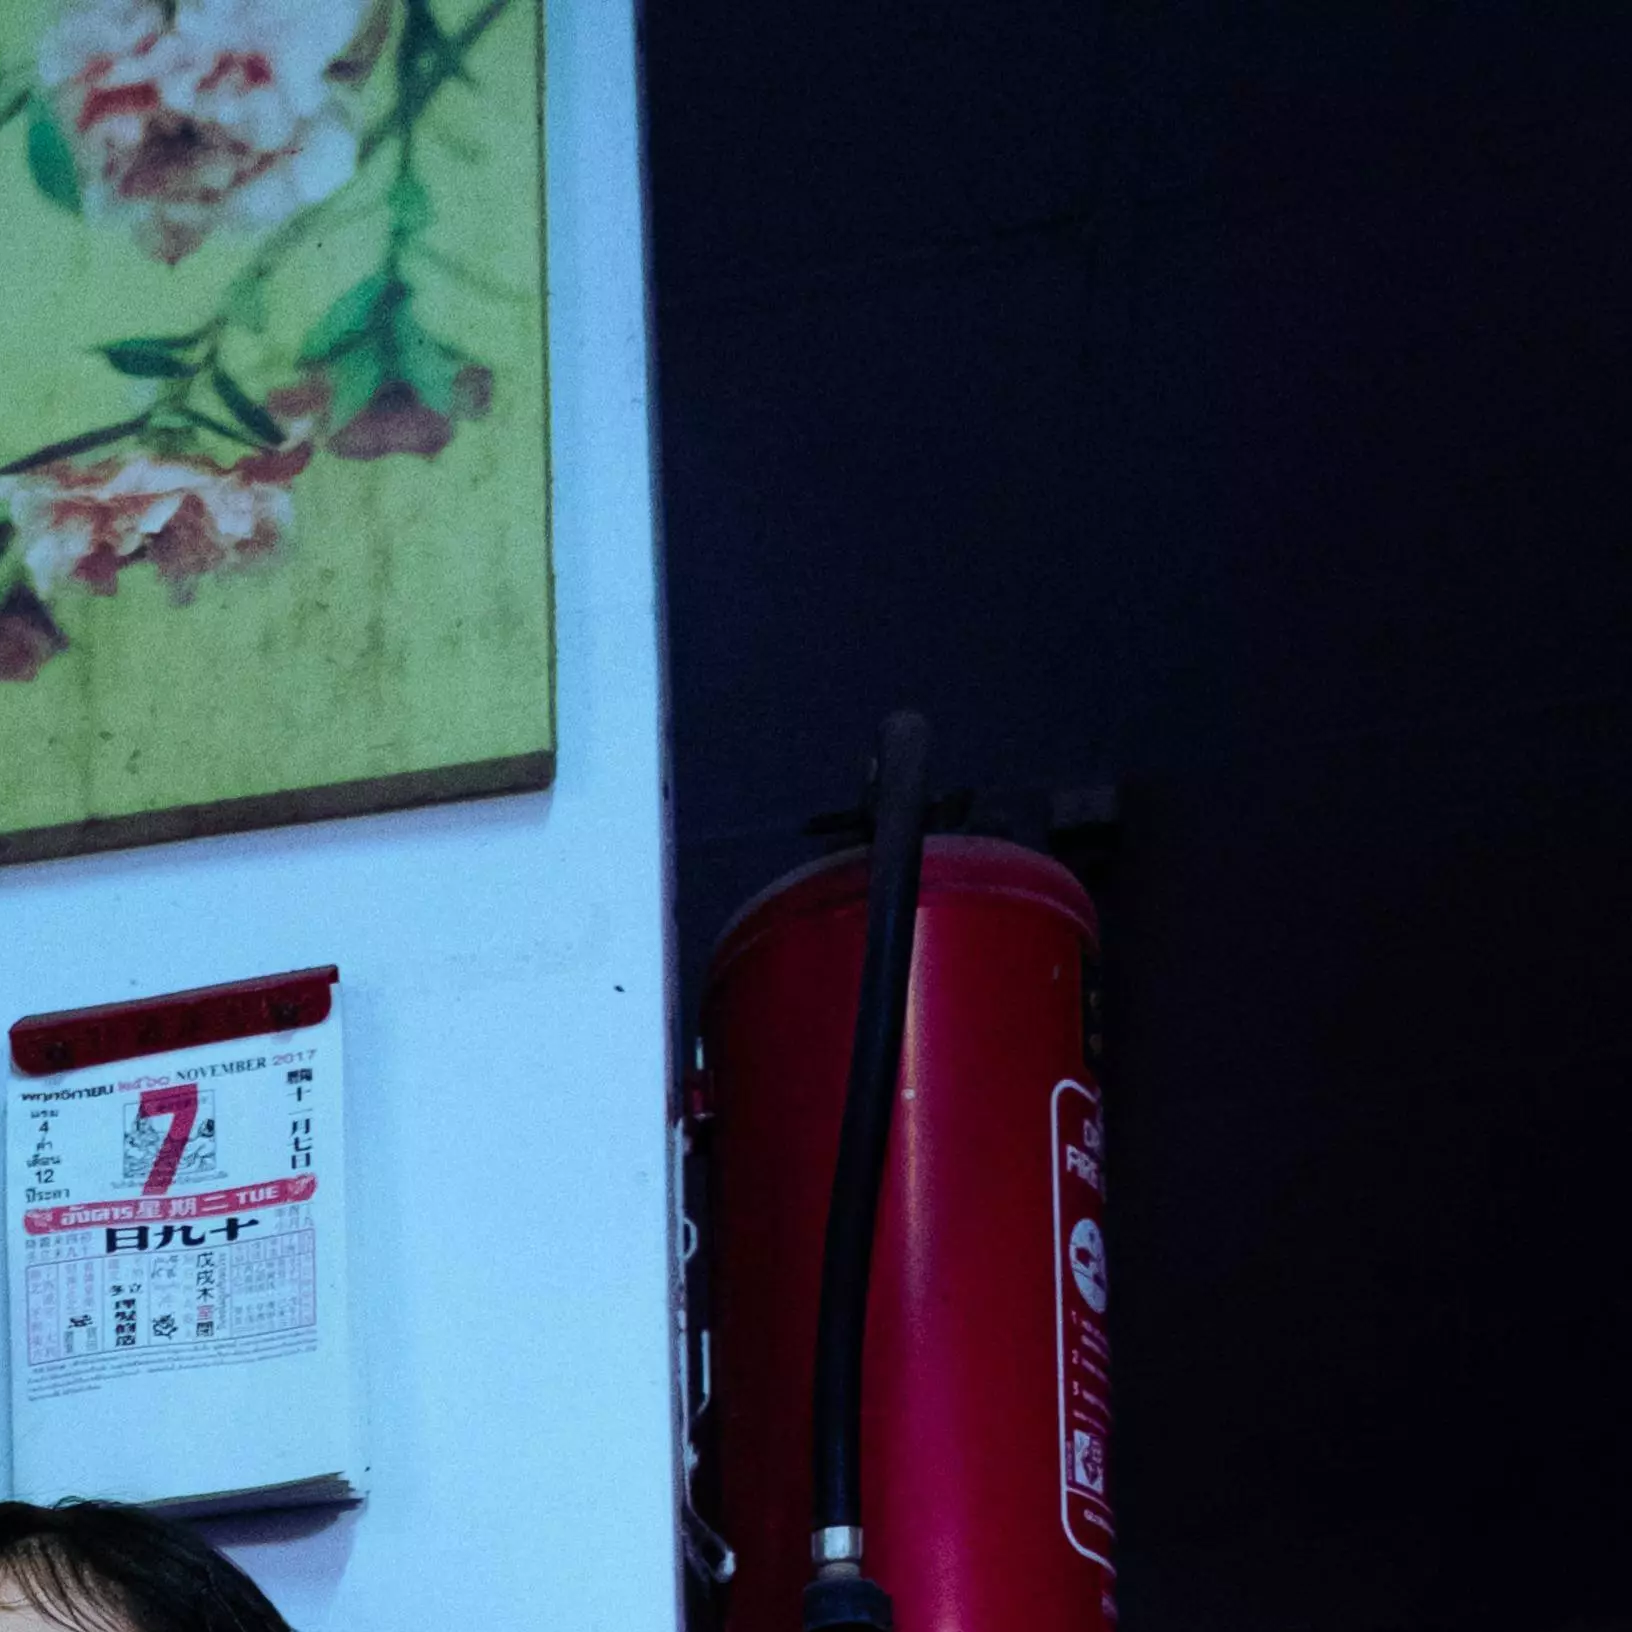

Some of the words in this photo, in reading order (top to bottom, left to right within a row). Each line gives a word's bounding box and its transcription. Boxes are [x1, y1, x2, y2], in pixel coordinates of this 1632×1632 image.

[176, 1057, 267, 1082] NOVEMBER
[272, 1050, 317, 1067] 2017
[38, 1121, 49, 1133] 4
[139, 1083, 199, 1196] 7
[35, 1169, 54, 1184] 12
[235, 1187, 280, 1205] TUE
